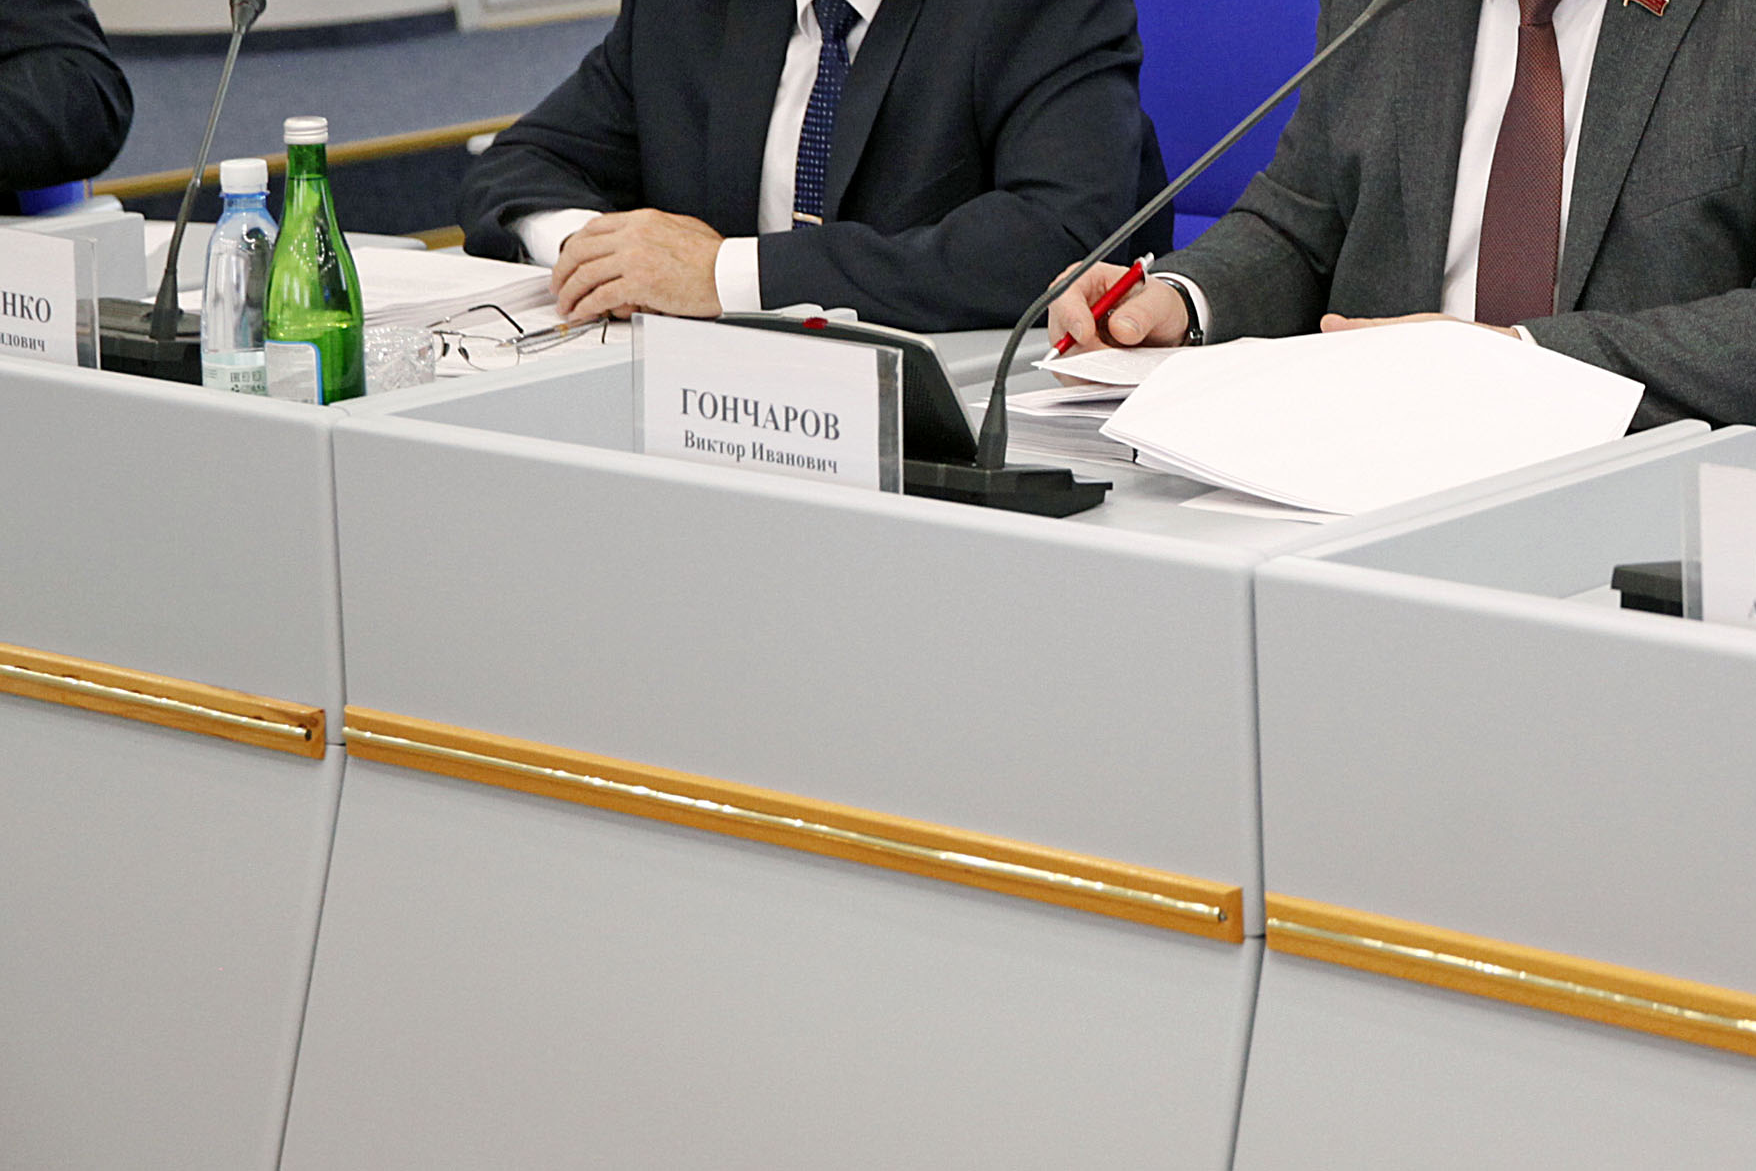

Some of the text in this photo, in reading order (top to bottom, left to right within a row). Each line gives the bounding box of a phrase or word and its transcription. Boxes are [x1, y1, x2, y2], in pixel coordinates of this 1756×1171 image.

[681, 388, 840, 441] ГОНЧАРОВ
[684, 430, 838, 474] Виктор Иванович
